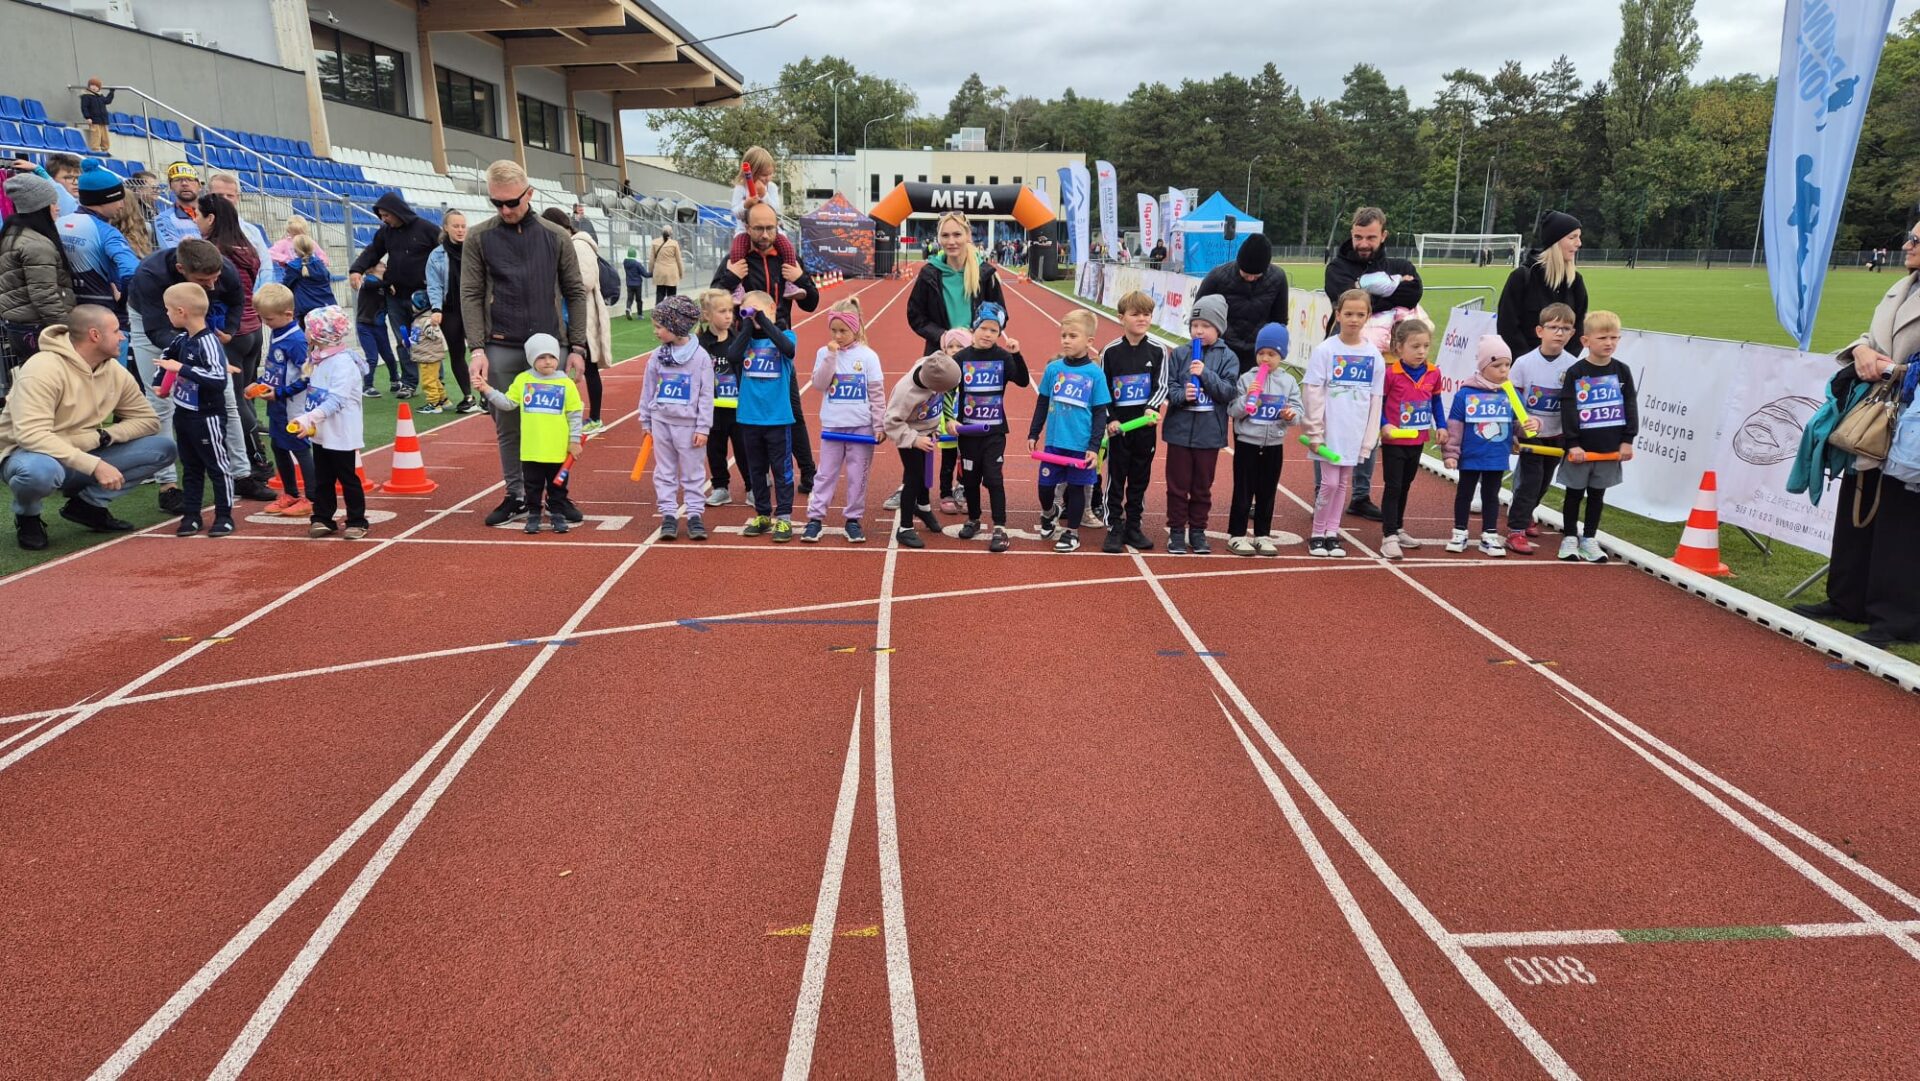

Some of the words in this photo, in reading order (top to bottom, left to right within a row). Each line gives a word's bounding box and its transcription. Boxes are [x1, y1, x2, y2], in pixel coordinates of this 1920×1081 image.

[931, 189, 995, 209] META
[818, 245, 858, 254] PLUS
[757, 358, 775, 371] 7/1
[975, 372, 1000, 385] 12/1
[1349, 366, 1367, 380] 9/1
[176, 386, 191, 402] 2/1
[663, 384, 683, 397] 6/1
[839, 385, 863, 398] 17/1
[1064, 383, 1083, 399] 8/1
[1126, 386, 1144, 398] 5/1
[1591, 387, 1618, 401] 13/1
[535, 393, 561, 408] 14/1
[1645, 394, 1688, 416] Zdrowie
[975, 406, 1000, 419] 12/2
[1260, 406, 1281, 419] 19/
[1481, 403, 1507, 416] 18/1
[1594, 407, 1621, 421] 13/2
[1641, 416, 1695, 441] Medycyna
[1637, 436, 1687, 463] Edukacja
